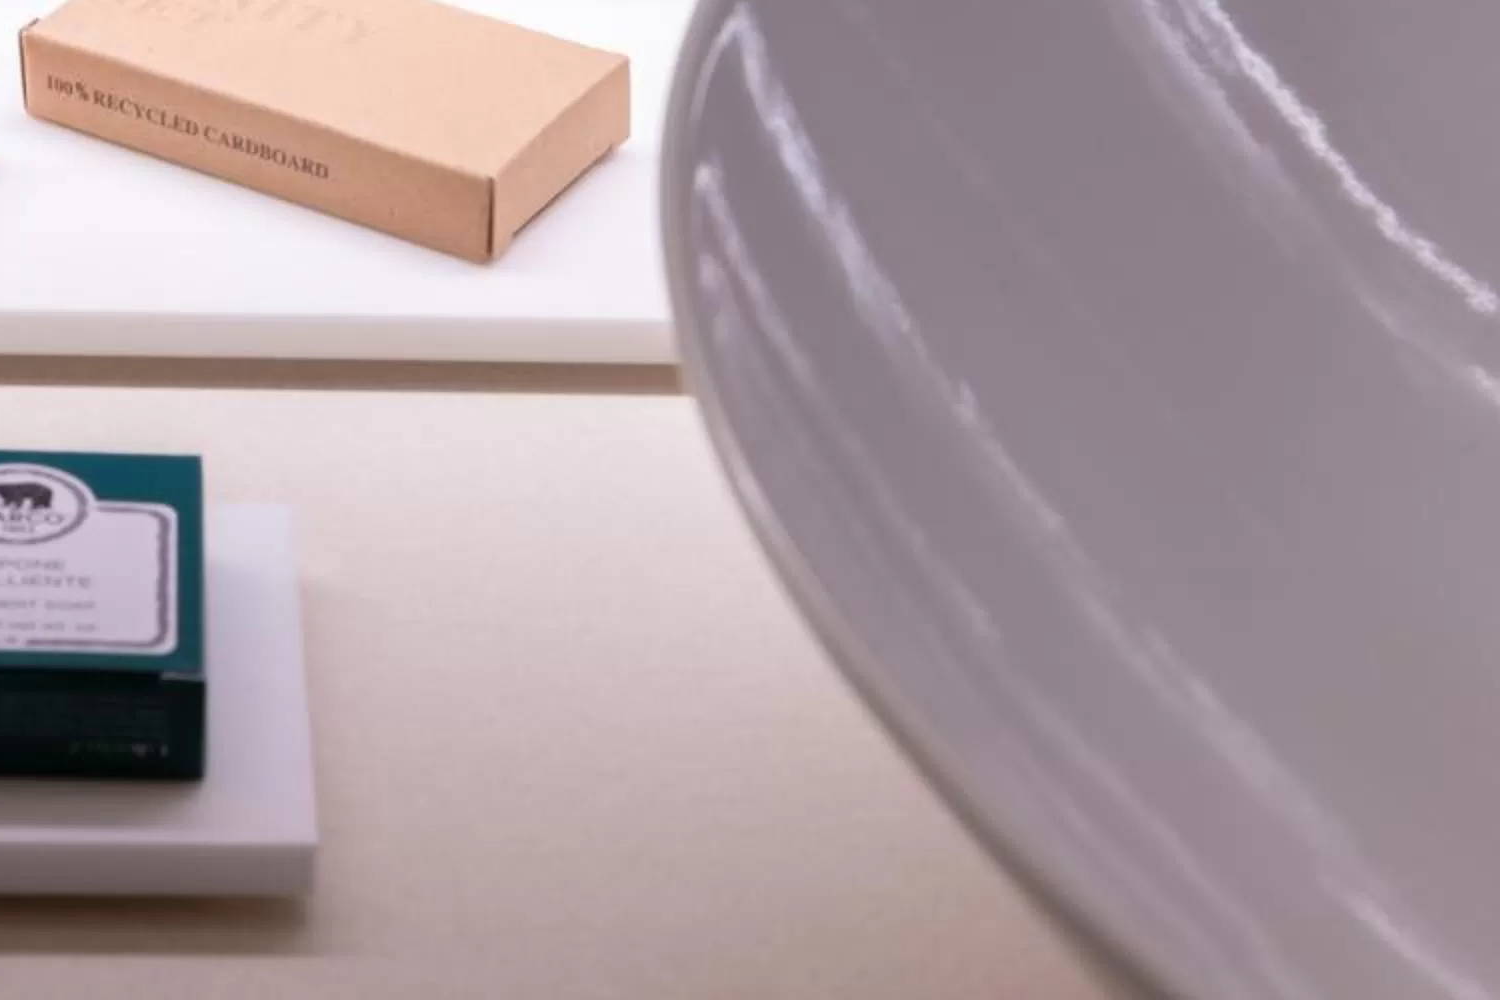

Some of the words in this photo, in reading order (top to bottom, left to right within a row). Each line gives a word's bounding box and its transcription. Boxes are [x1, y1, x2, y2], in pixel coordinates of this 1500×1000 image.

[47, 75, 90, 102] 100%
[93, 89, 199, 137] RECYCLED
[203, 124, 329, 179] CARDBOARD
